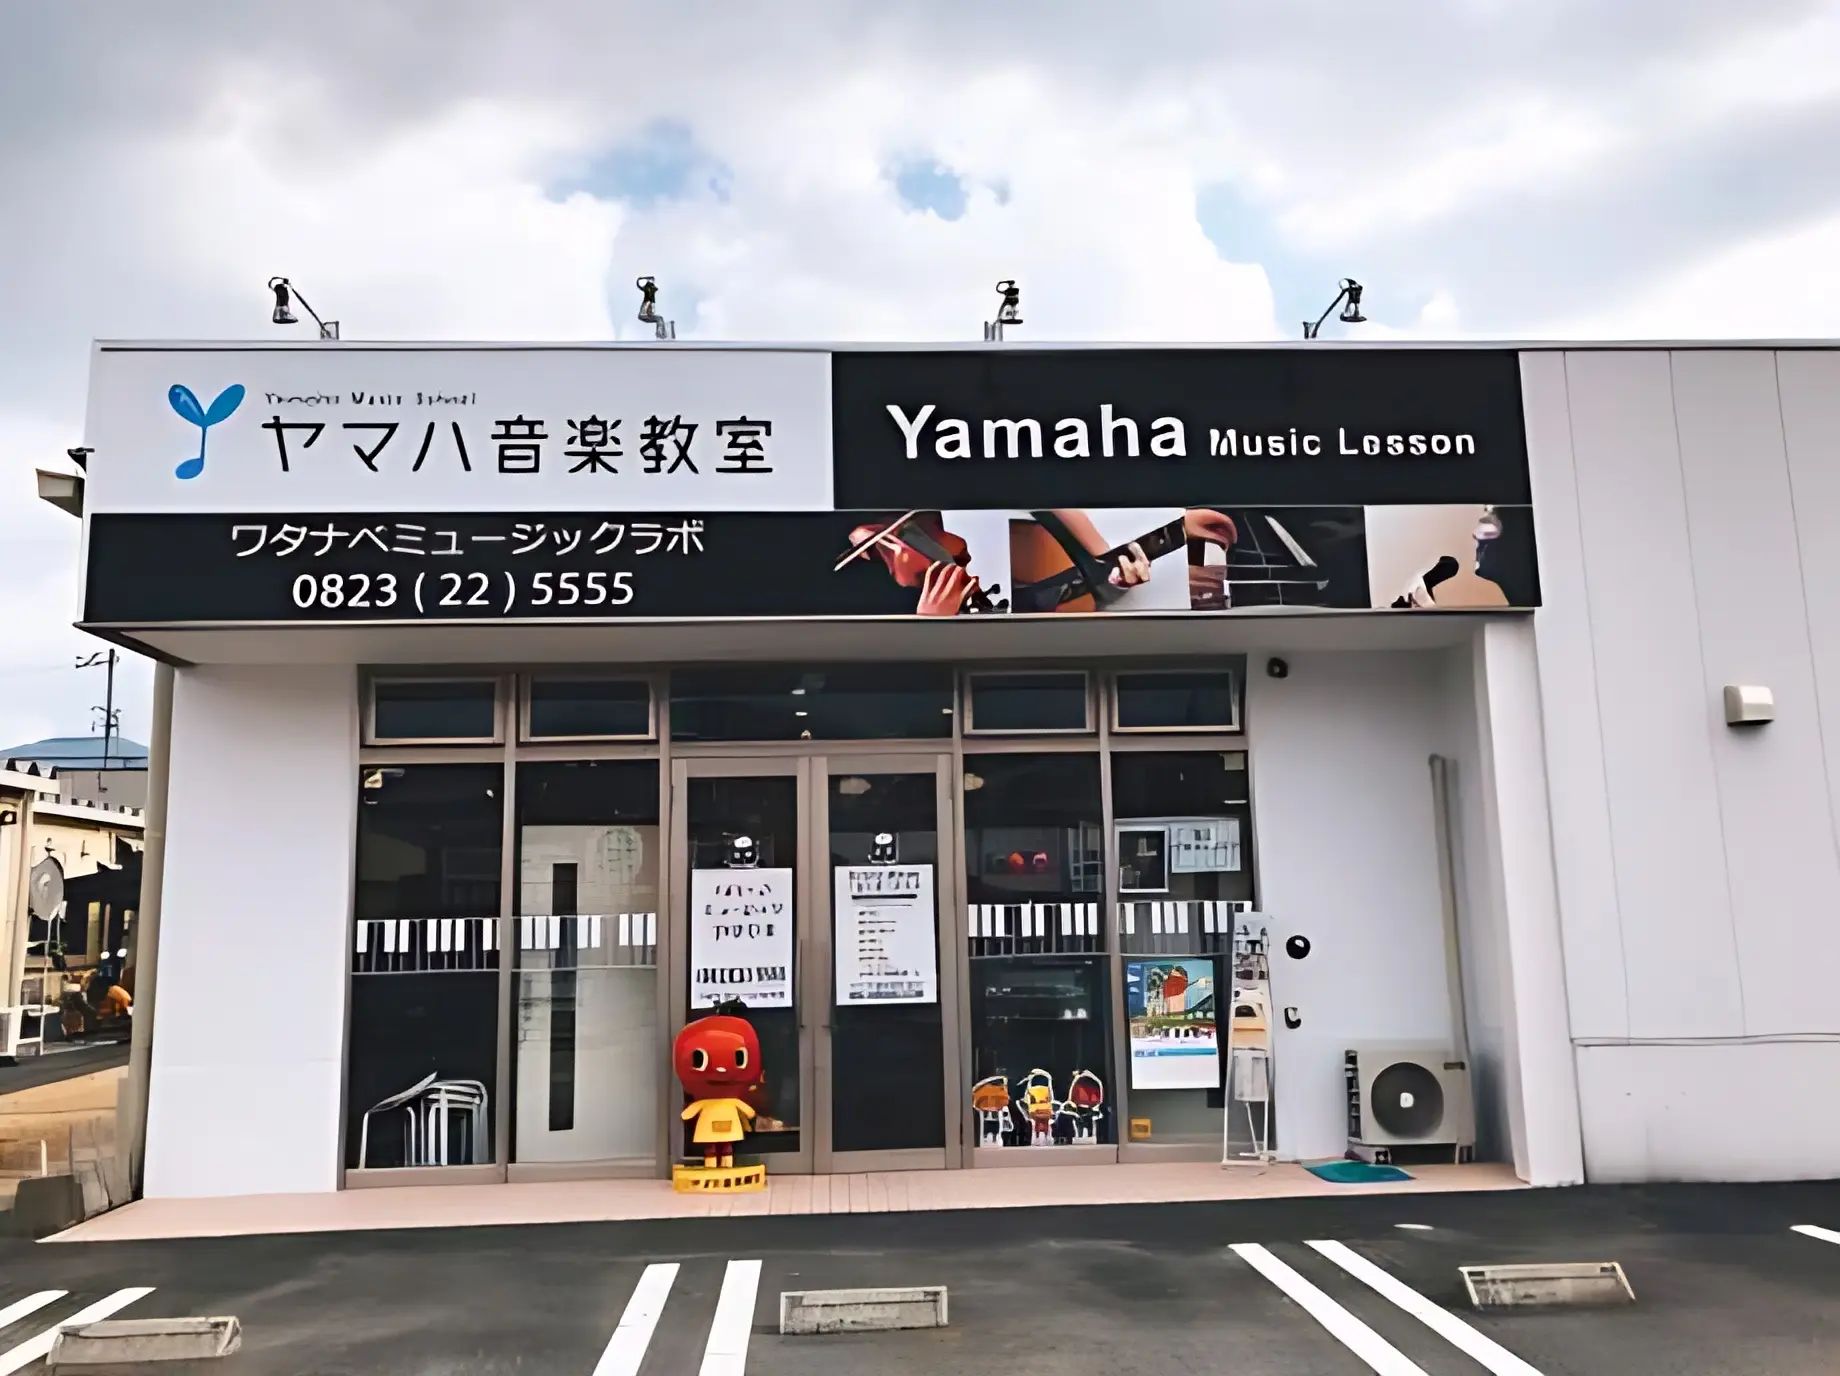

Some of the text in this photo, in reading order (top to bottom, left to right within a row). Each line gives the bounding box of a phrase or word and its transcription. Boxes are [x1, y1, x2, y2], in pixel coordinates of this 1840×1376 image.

[261, 414, 774, 475] ヤマハ音楽教室
[885, 403, 1475, 459] Yamaha Music Lesson
[231, 519, 704, 557] ワタナベミュージックラボ
